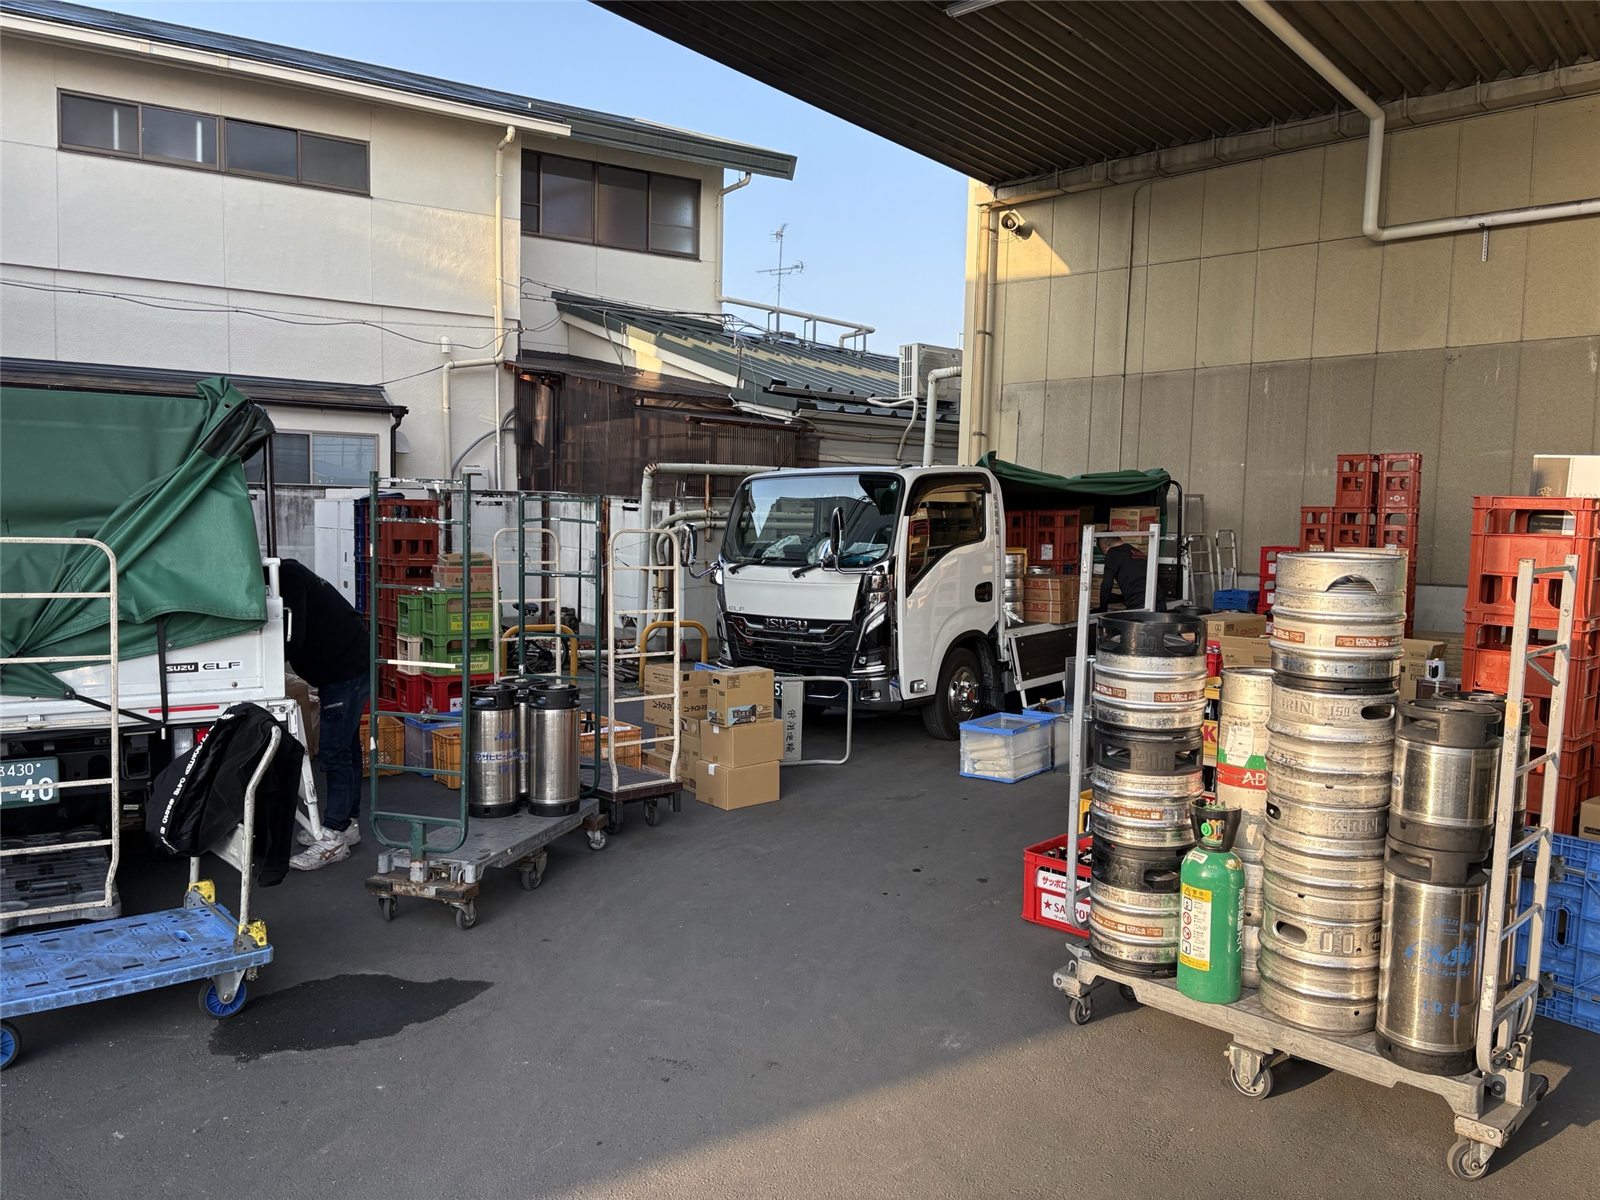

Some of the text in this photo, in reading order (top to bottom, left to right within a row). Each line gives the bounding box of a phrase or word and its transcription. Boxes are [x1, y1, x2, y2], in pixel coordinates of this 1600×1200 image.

[765, 618, 808, 630] ISUZU
[166, 662, 240, 672] SUZU ELF
